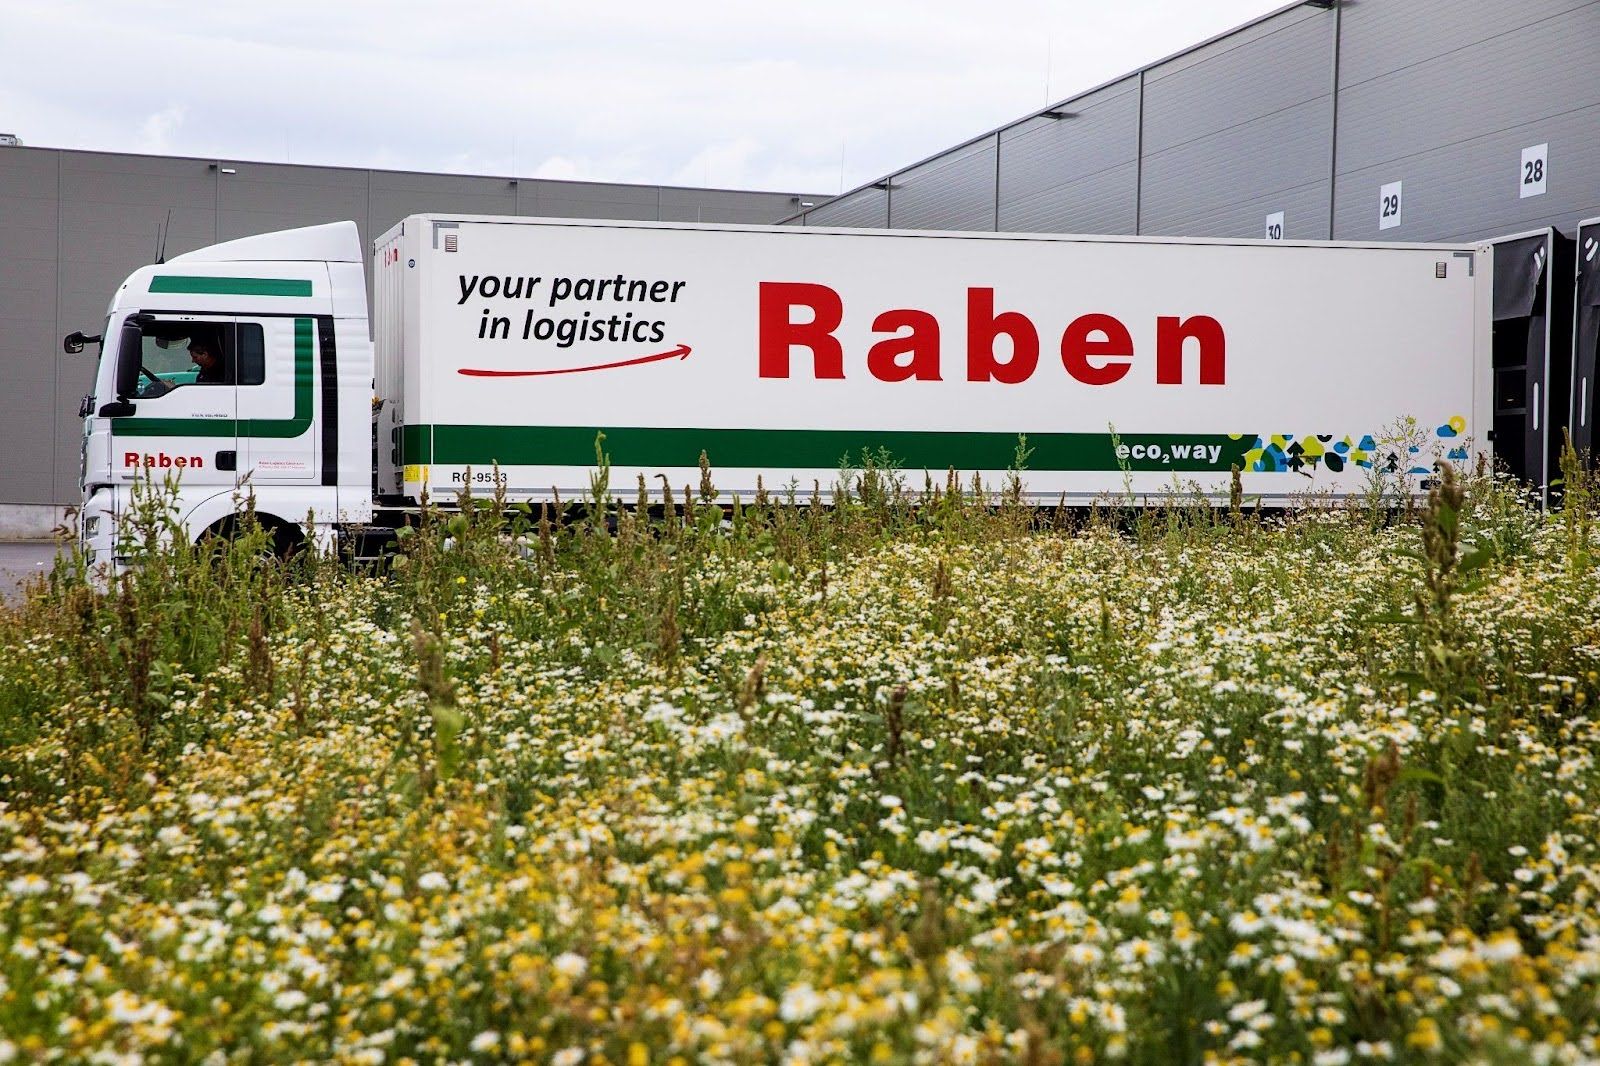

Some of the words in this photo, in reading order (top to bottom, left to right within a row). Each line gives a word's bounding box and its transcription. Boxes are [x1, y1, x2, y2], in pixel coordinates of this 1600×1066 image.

[1524, 159, 1543, 185] 28
[1383, 194, 1398, 218] 29
[1268, 223, 1281, 240] 30
[457, 275, 542, 305] your
[549, 274, 687, 308] partner
[478, 308, 511, 340] in
[522, 308, 666, 348] logistics
[758, 281, 1226, 386] Raben
[124, 452, 203, 468] Raben
